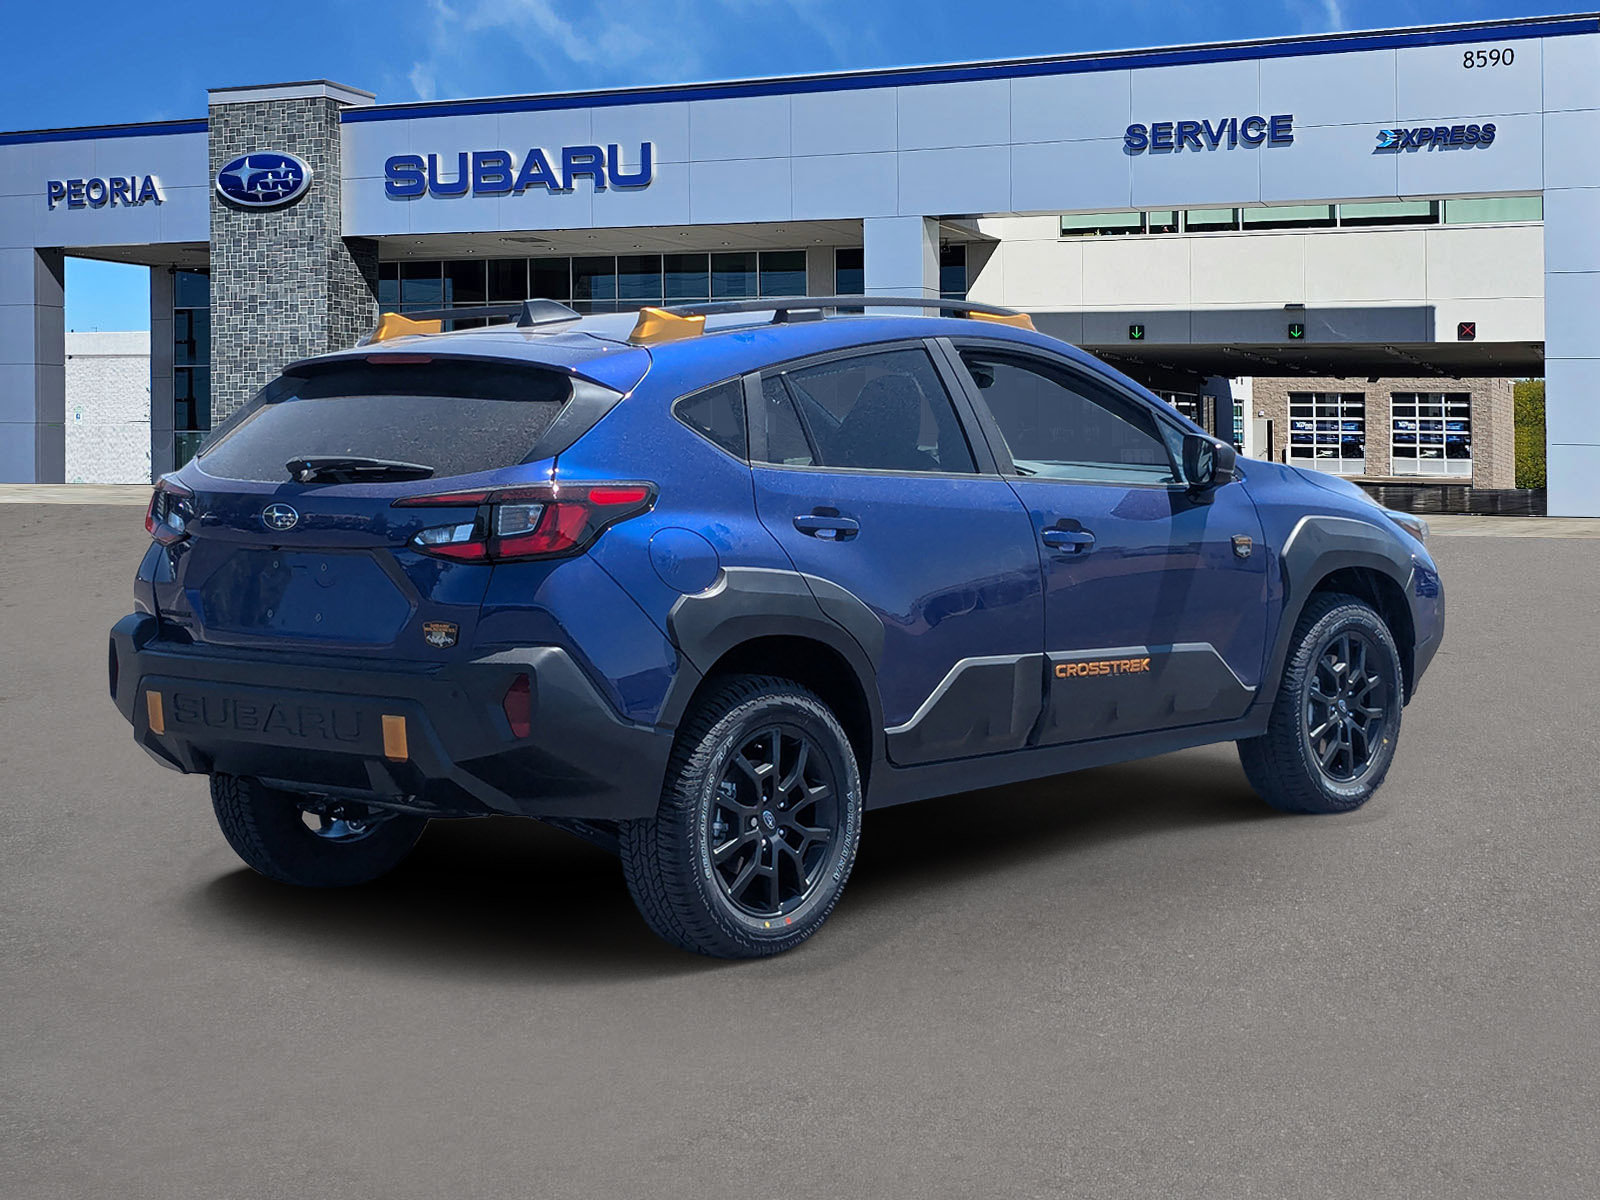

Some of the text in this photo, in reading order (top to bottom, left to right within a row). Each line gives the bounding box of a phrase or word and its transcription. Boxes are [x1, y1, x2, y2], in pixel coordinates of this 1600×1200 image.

[1462, 48, 1515, 69] 8590
[1124, 114, 1295, 152] SERVICE
[1375, 123, 1497, 149] EXPRESS
[384, 142, 652, 198] SUBARU
[47, 175, 162, 209] PEORIA
[1055, 658, 1151, 678] CROSSTREK
[173, 692, 363, 742] SUBARU
